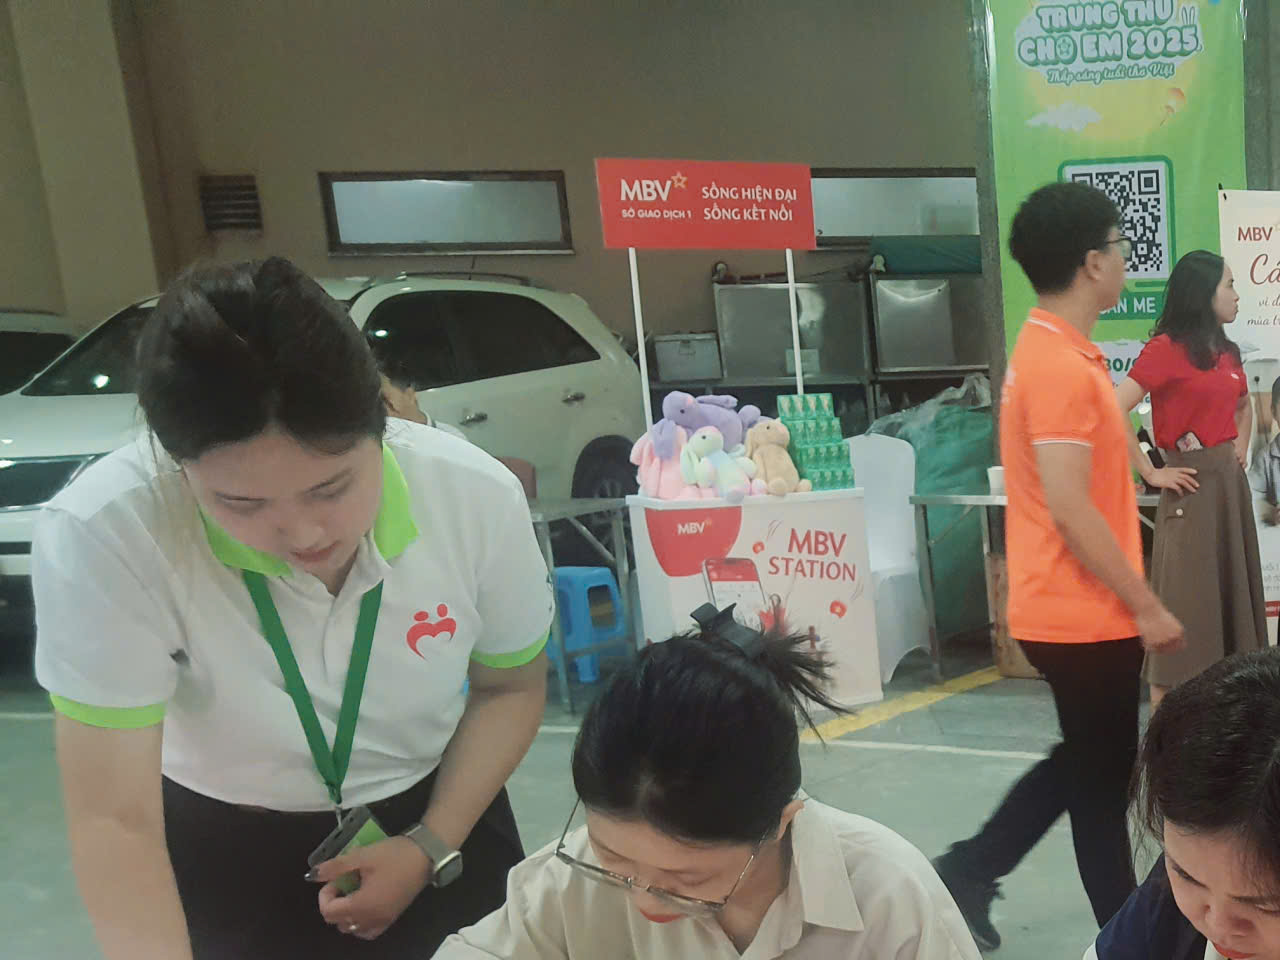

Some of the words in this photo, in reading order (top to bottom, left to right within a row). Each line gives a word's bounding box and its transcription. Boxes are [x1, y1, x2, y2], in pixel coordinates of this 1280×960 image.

[1037, 3, 1119, 32] TRUNG
[1121, 0, 1174, 27] THU
[1018, 35, 1077, 66] CHO
[1081, 31, 1123, 62] EM
[1127, 26, 1199, 60] 2025
[620, 179, 671, 201] MBV
[775, 188, 797, 203] ĐẠI
[638, 209, 661, 219] GIAO
[663, 209, 685, 220] DỊCH
[687, 209, 692, 218] 1
[1237, 226, 1273, 242] MBV
[1133, 297, 1157, 313] ME
[677, 521, 704, 535] MBV
[788, 527, 847, 557] MBV
[768, 556, 856, 582] STATION
